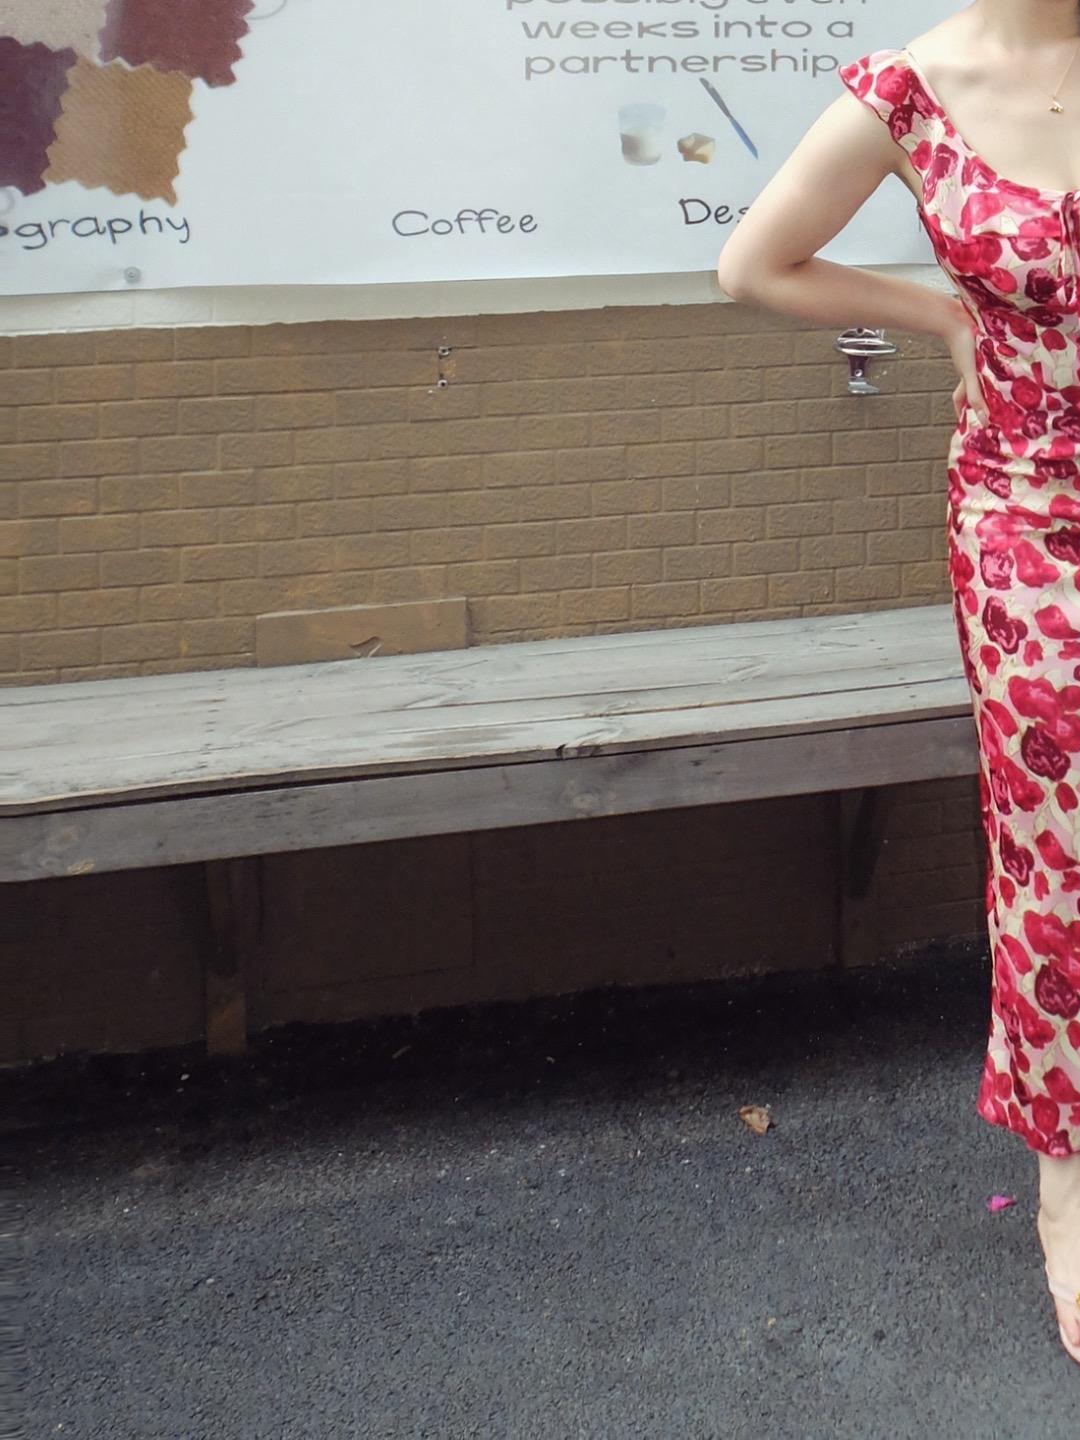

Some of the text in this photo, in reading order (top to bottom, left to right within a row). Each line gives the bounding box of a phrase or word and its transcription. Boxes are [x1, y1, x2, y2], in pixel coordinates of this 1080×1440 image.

[521, 14, 854, 40] weeks into a
[524, 48, 840, 81] partnership
[391, 207, 539, 238] Coffee
